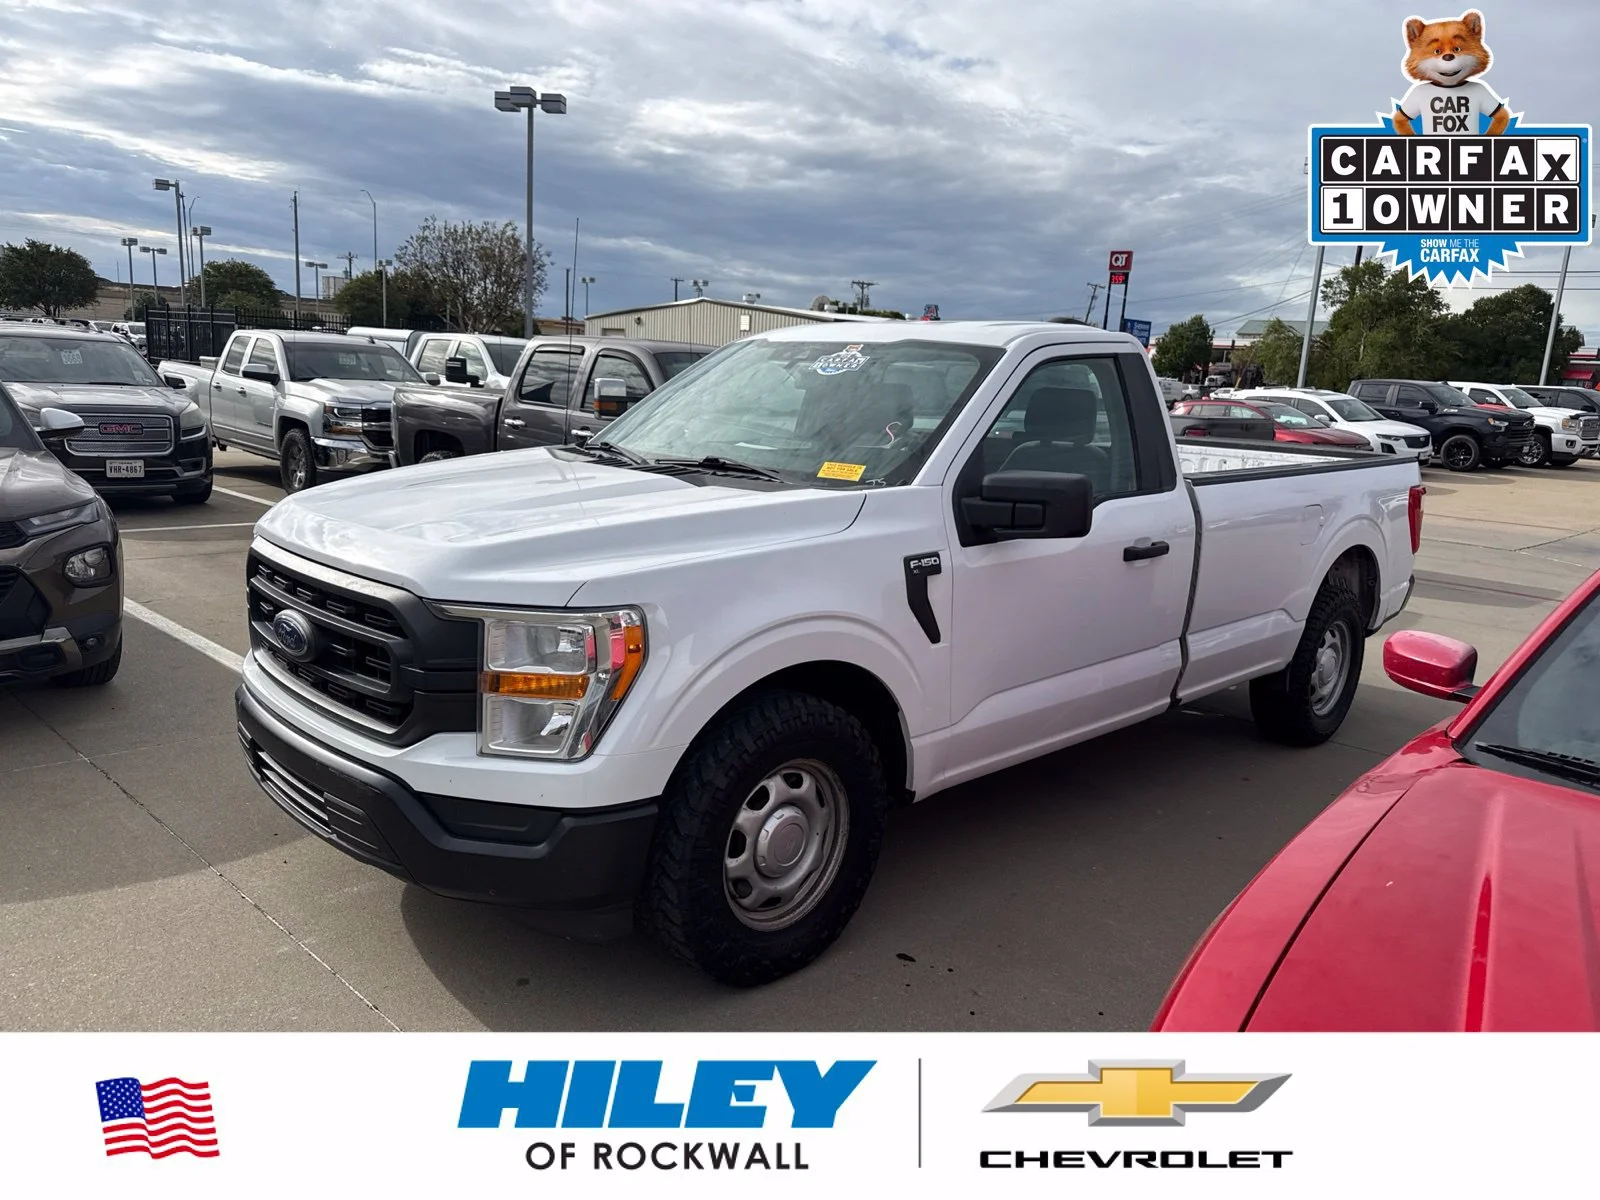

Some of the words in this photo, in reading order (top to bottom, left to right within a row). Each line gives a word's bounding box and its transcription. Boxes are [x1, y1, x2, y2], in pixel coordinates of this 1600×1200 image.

[1112, 253, 1129, 267] QT
[100, 424, 142, 434] GMC
[910, 557, 940, 569] F-150
